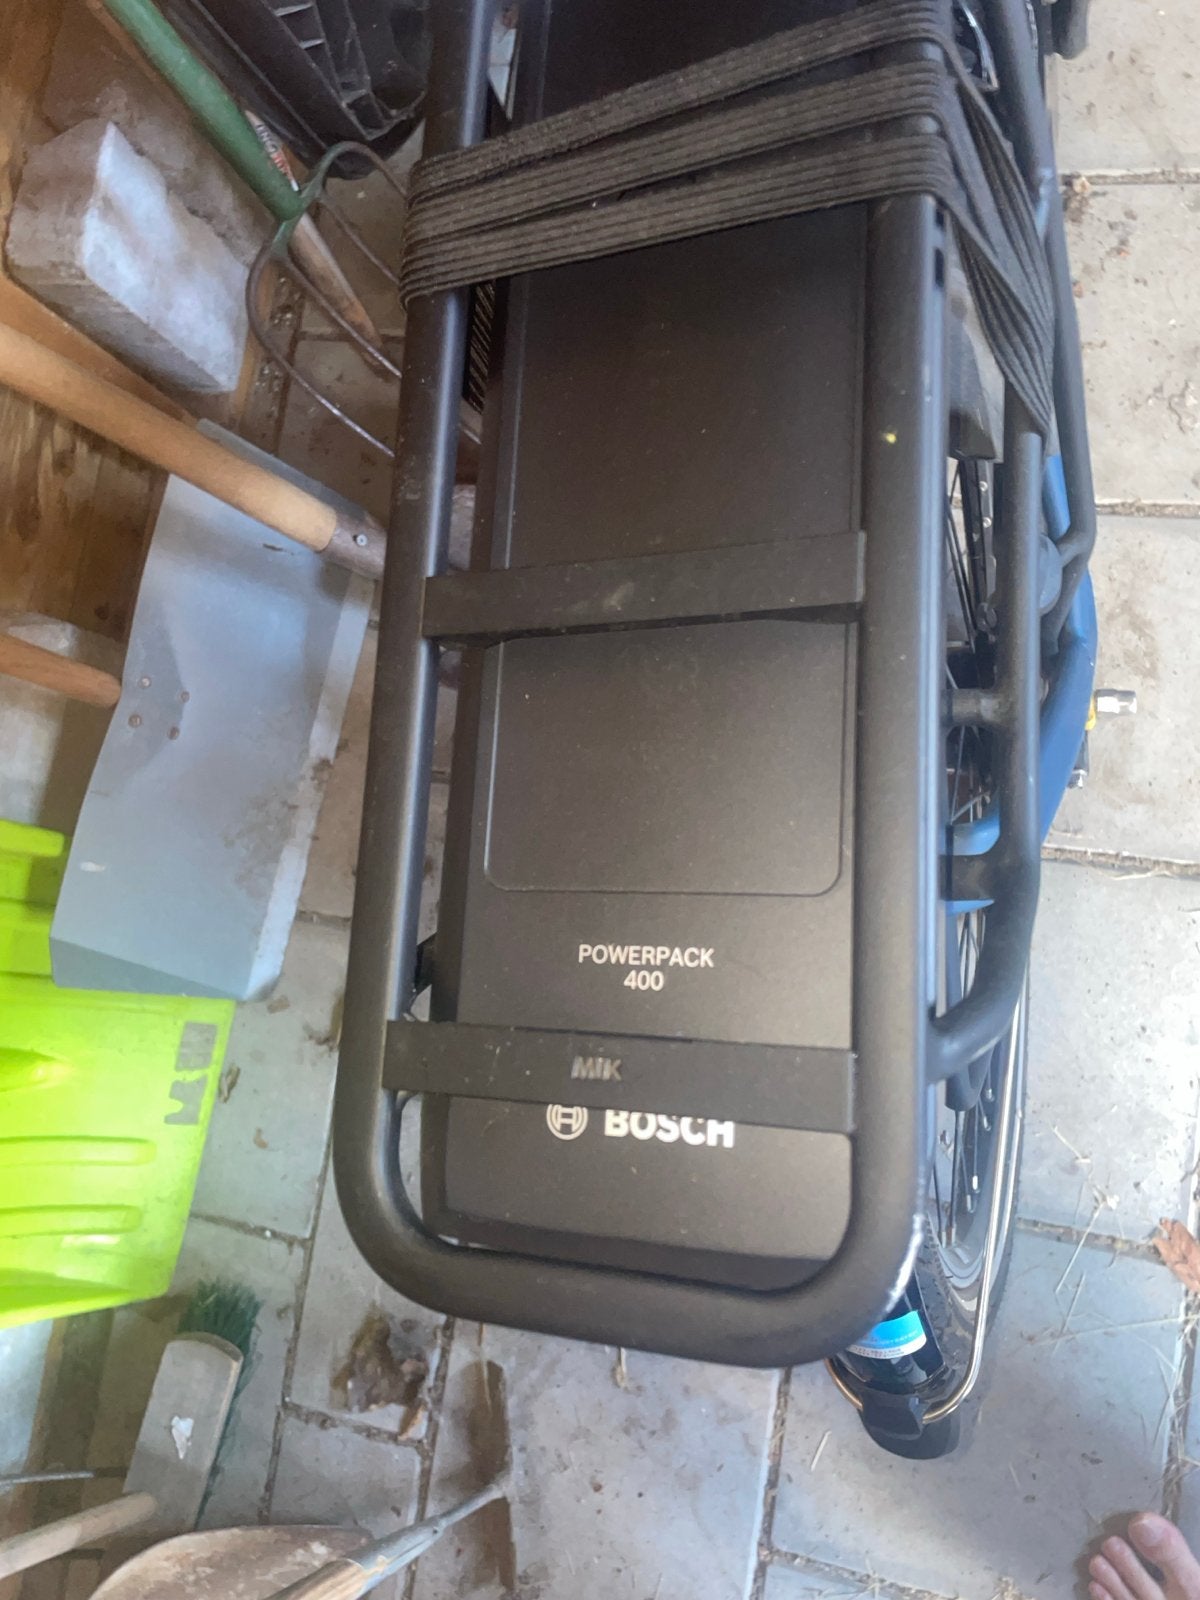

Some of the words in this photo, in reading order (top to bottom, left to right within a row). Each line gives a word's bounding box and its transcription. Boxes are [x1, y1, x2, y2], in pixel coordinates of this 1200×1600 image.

[578, 944, 715, 968] POWERPACK
[623, 970, 665, 991] 400
[604, 1109, 735, 1148] BOSCH
